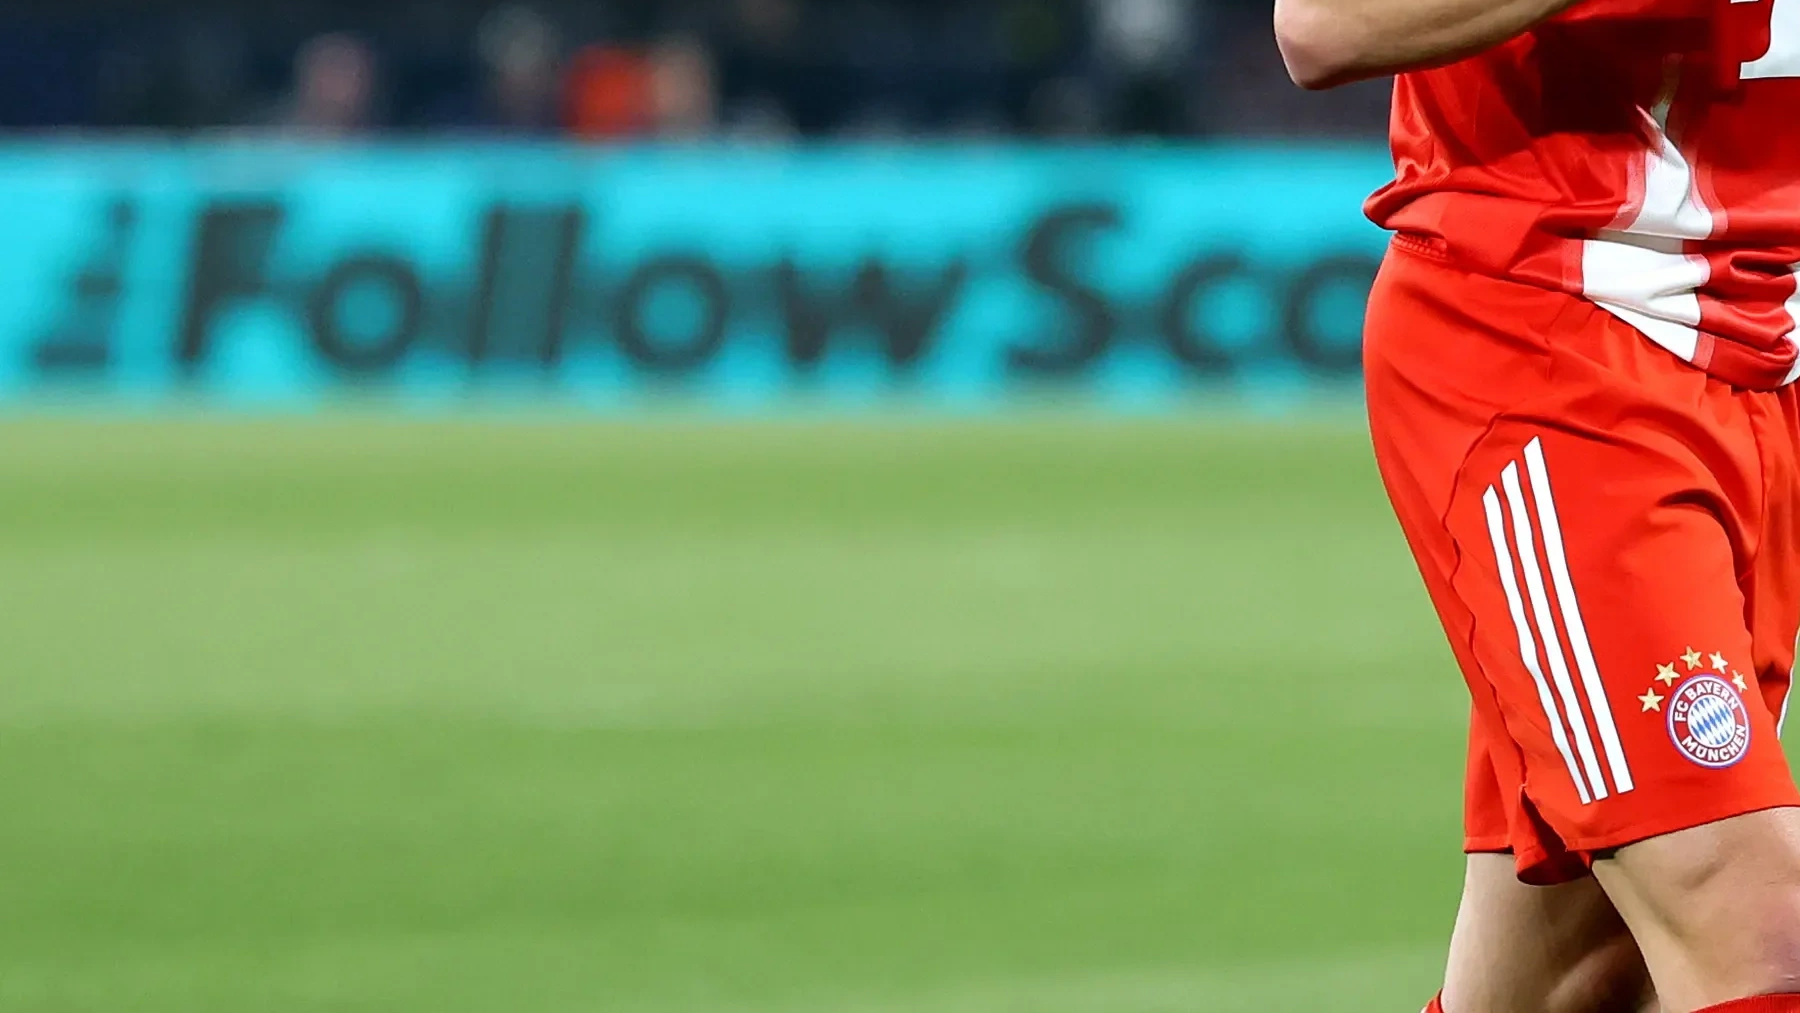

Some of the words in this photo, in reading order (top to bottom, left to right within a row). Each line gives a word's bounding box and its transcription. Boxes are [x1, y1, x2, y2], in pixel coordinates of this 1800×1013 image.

[1674, 700, 1689, 722] FC
[1685, 681, 1738, 710] BAYERN
[1682, 724, 1746, 762] MÜNCHEN
